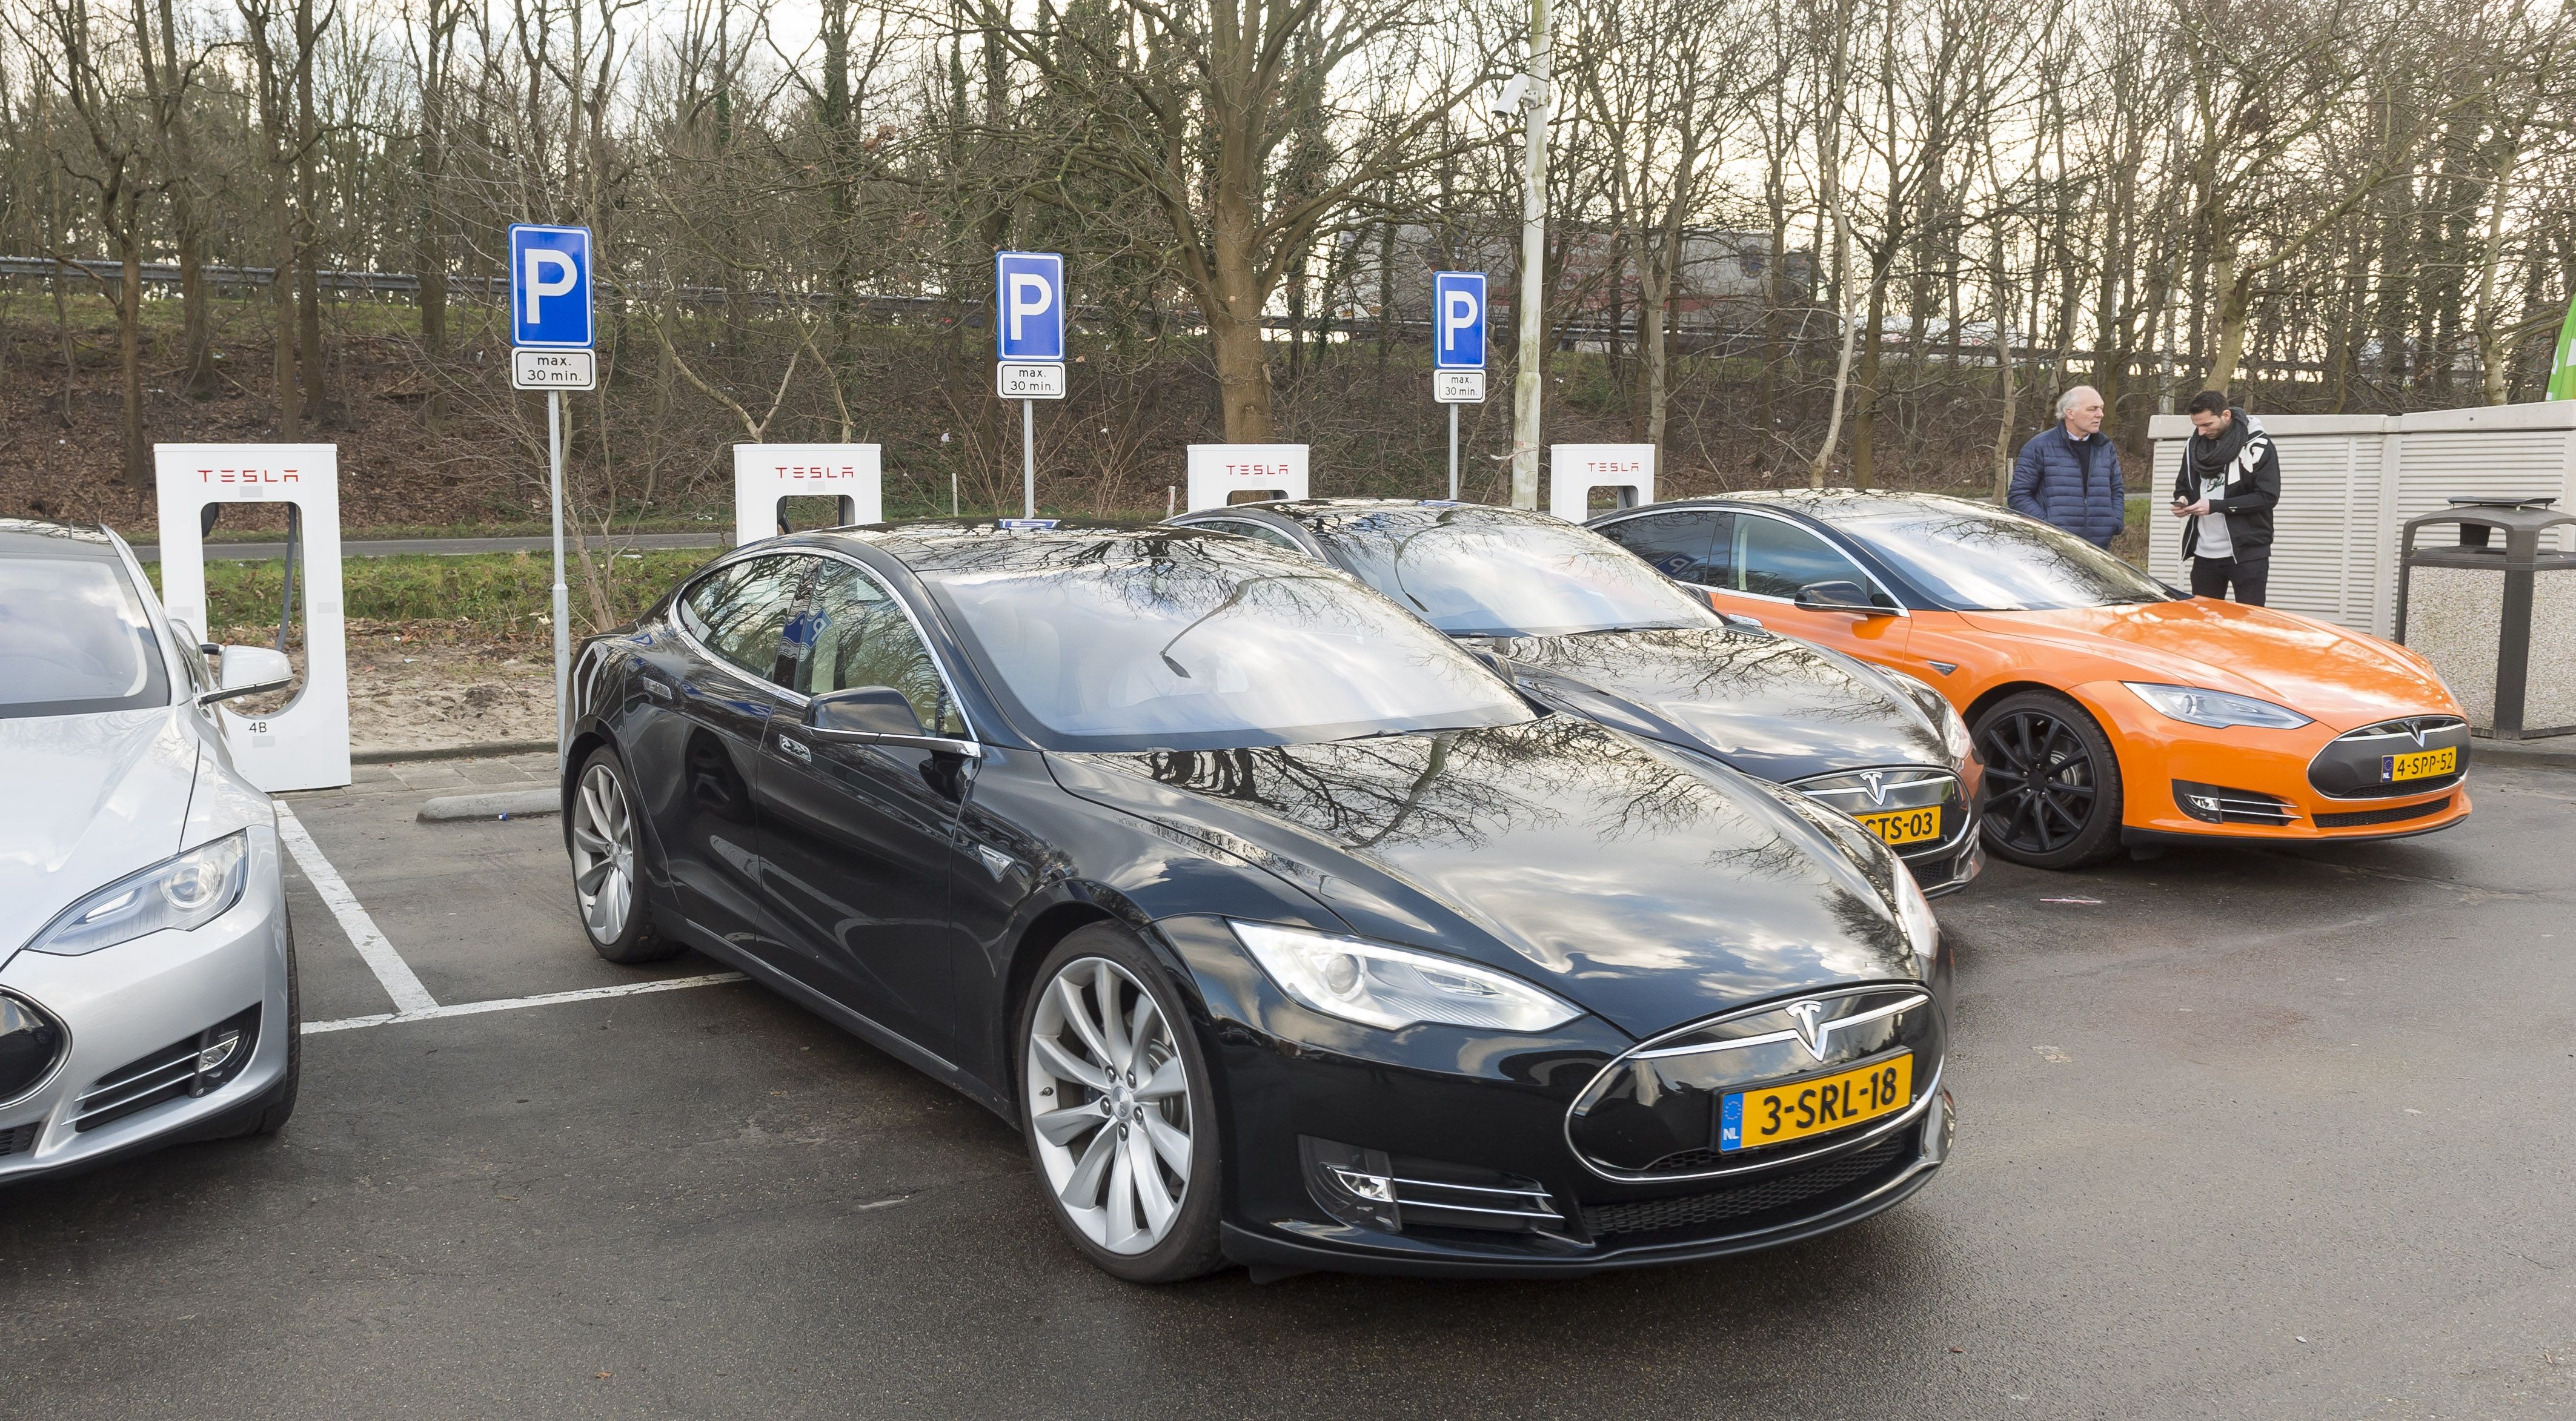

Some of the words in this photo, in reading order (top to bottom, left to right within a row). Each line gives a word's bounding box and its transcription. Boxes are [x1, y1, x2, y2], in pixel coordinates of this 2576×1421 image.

[524, 248, 577, 324] P
[1009, 273, 1053, 340] P
[1444, 290, 1478, 351] P
[537, 357, 571, 366] max.
[527, 369, 546, 381] 30
[551, 369, 582, 381] min.
[1018, 369, 1046, 377] max.
[1011, 380, 1026, 391] 30
[1029, 381, 1054, 391] min.
[1451, 375, 1472, 384] max.
[1445, 386, 1456, 396] 30
[1459, 386, 1478, 396] min.
[775, 466, 854, 479] TESLA
[1226, 465, 1289, 475] TESLA
[1587, 462, 1639, 472] TESLA
[197, 469, 299, 483] TESLA
[248, 722, 268, 733] 4B
[2397, 752, 2453, 776] 4-SPP-52
[1761, 1067, 1896, 1135] 3-SRL-18
[1723, 1127, 1739, 1141] NL
